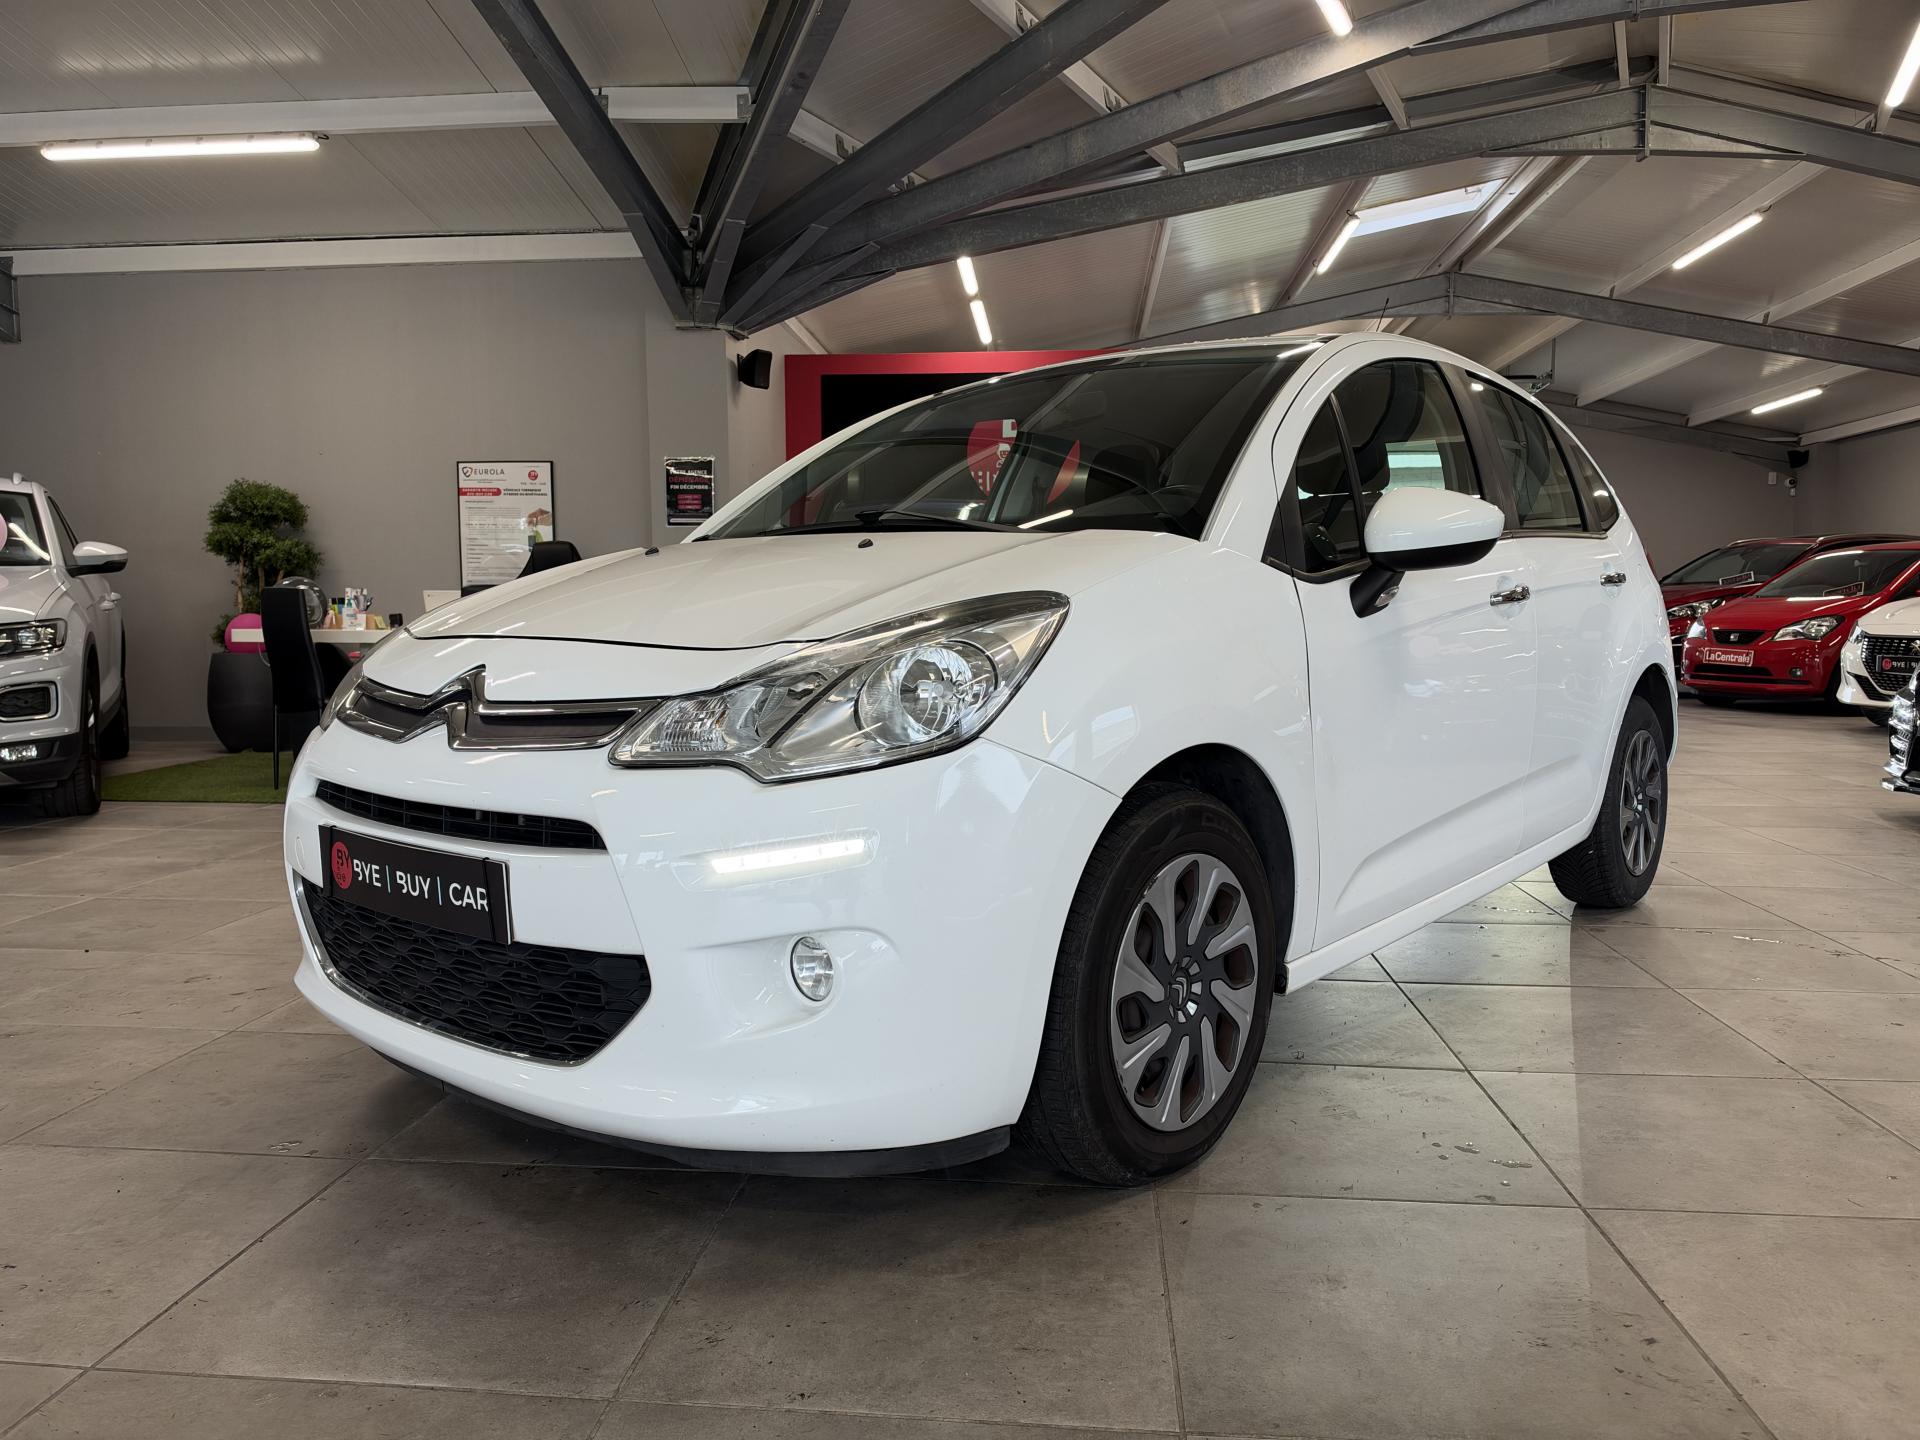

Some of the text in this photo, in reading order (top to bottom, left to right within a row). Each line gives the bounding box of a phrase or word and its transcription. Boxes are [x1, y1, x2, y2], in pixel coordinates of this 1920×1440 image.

[474, 468, 505, 476] EUROLA
[353, 859, 382, 887] BYE
[396, 871, 431, 899] BUY
[449, 882, 489, 912] CAR
